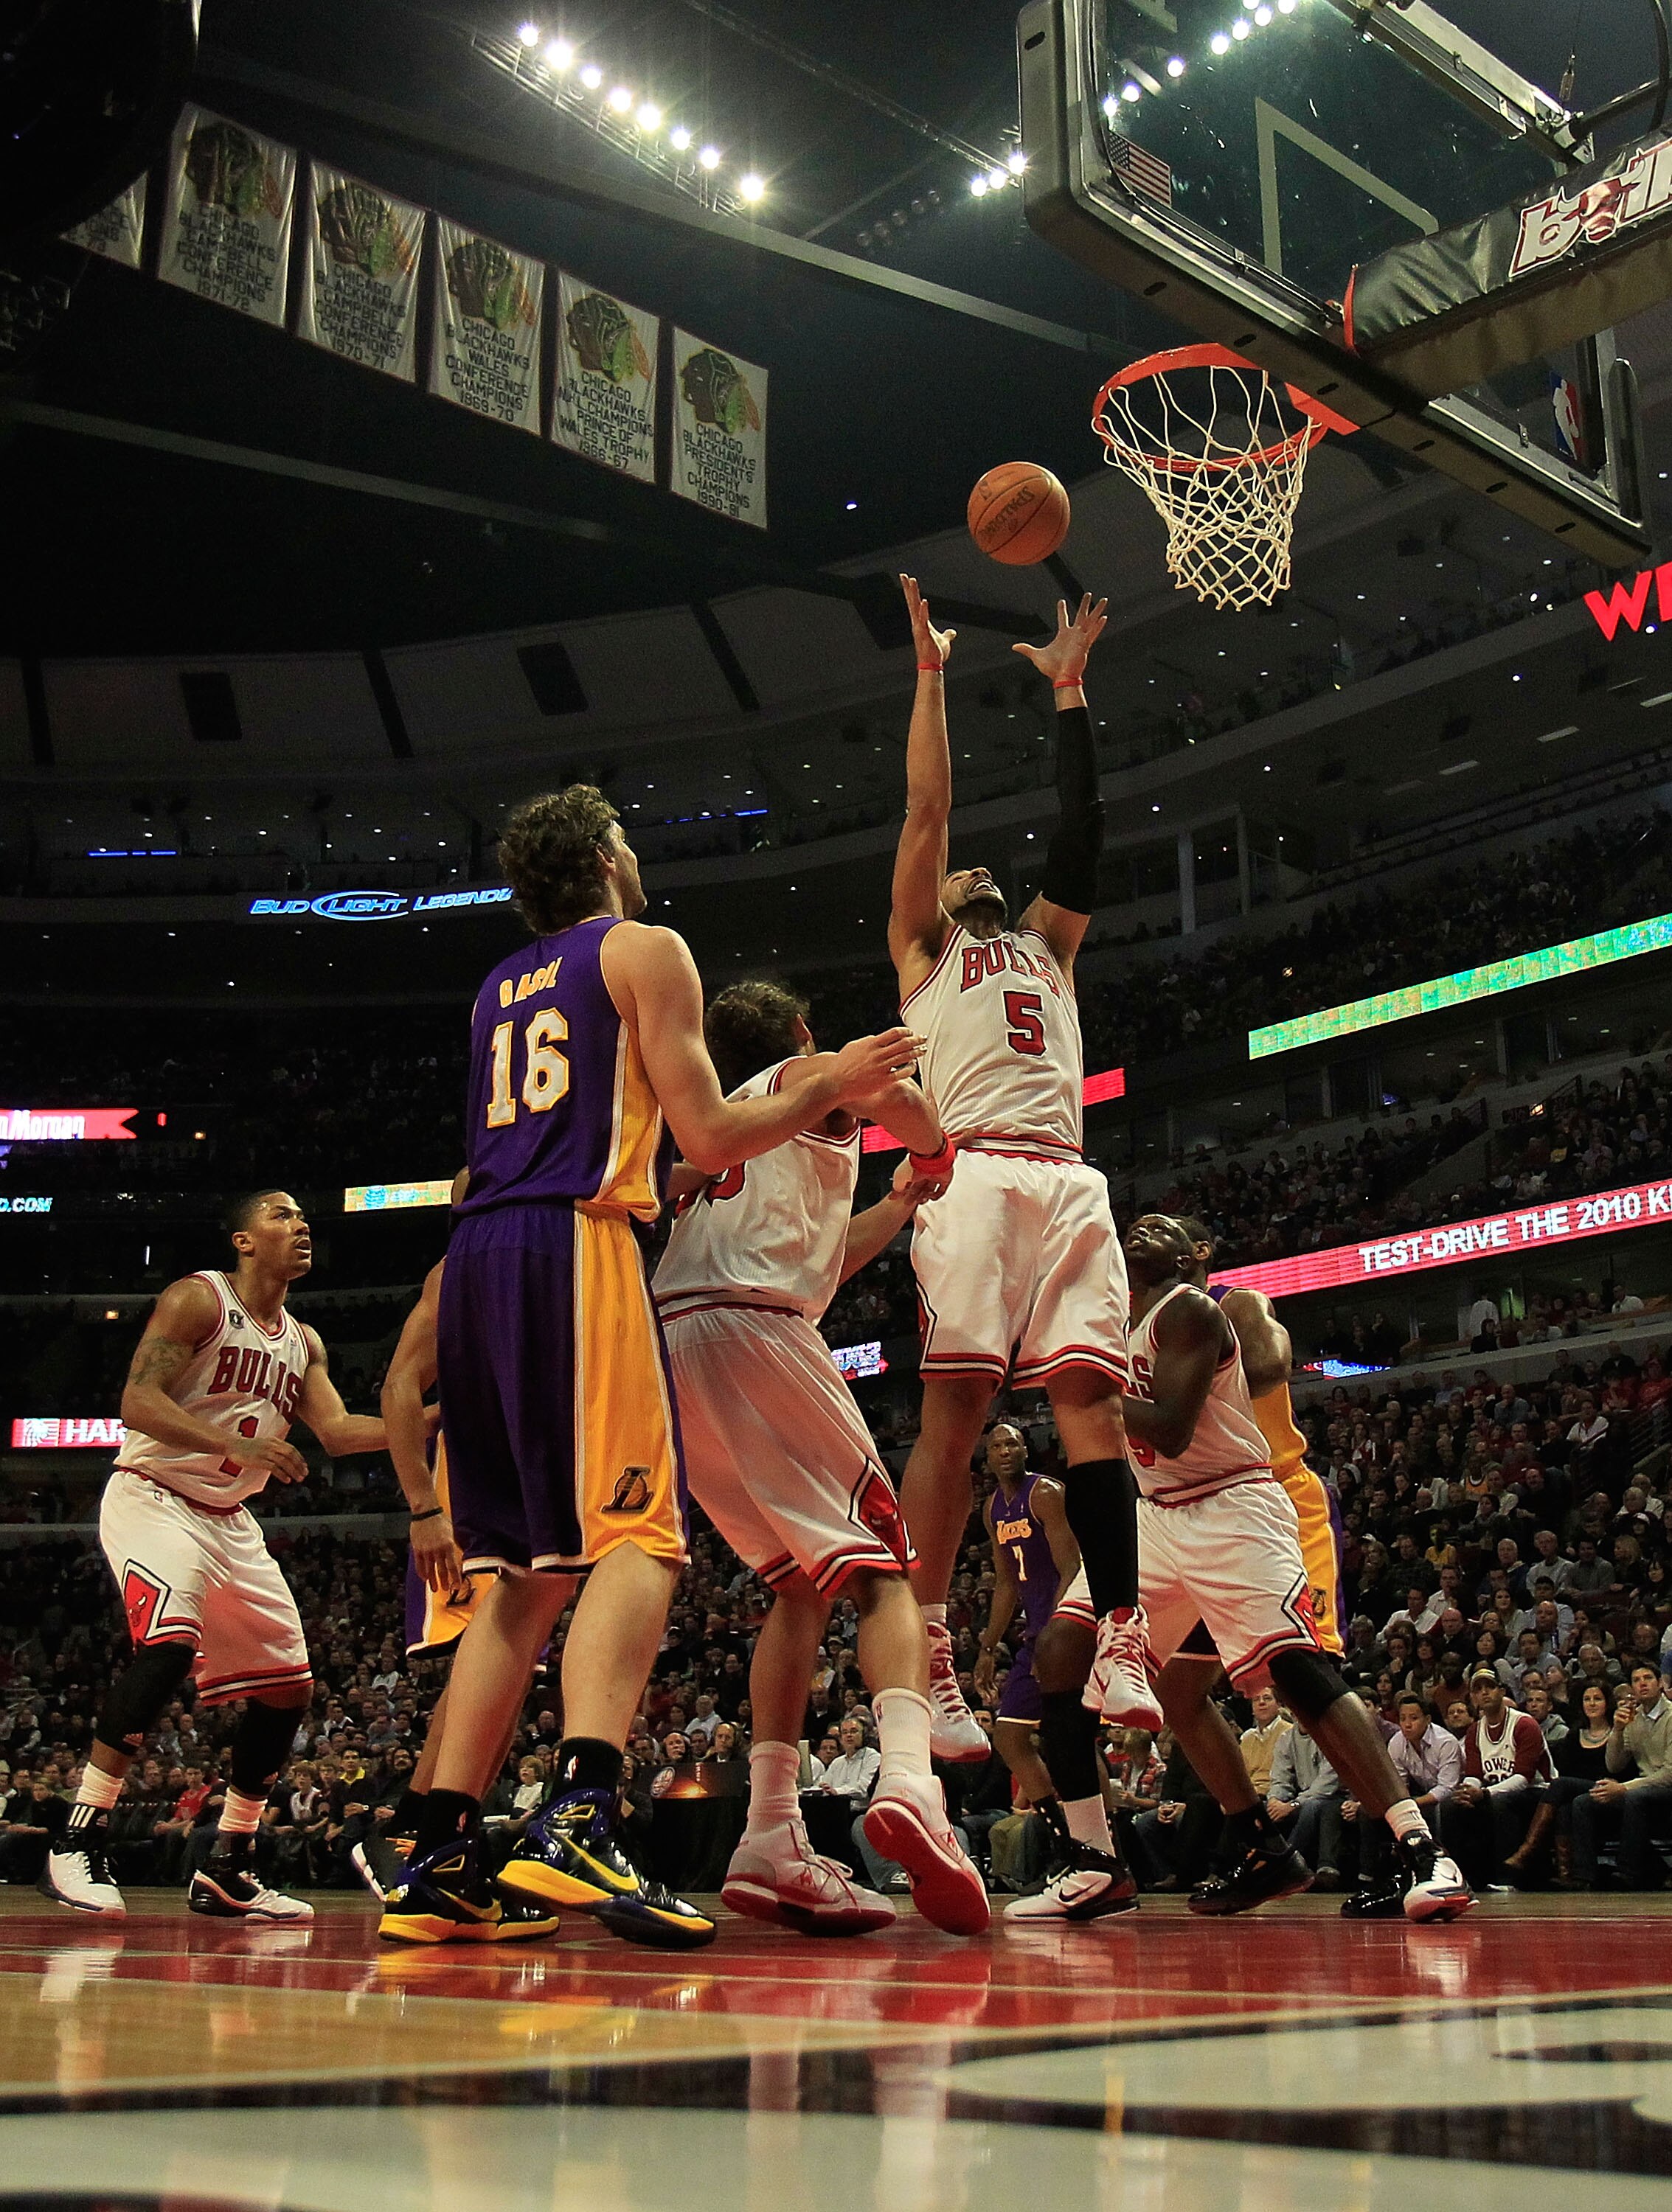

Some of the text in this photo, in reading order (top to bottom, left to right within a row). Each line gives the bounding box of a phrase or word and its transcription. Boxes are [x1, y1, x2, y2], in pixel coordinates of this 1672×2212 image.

[200, 206, 260, 240] CHICAGO
[334, 264, 391, 299] CHICAGO
[321, 317, 396, 359] CHAMPIONS
[333, 337, 384, 368] 1970-71
[445, 323, 530, 370] BLACKHAWKS
[462, 318, 515, 350] CHICAGO
[446, 354, 529, 398] CONFERENCE
[469, 349, 509, 378] WALES
[451, 372, 523, 411] CHAMPIONS
[569, 378, 646, 422] BLACKHAWKS
[581, 371, 631, 403] CHICAGO
[461, 390, 514, 422] 1969-70
[588, 402, 653, 437] CHAMPIONS
[560, 415, 650, 464] WALES TROPHY
[577, 410, 634, 444] PRINCE OF
[696, 422, 743, 453] CHICAGO
[579, 439, 628, 469] 1966-67
[683, 429, 756, 471] BLACKHAWKS
[684, 444, 753, 483] PRESIDENTS
[687, 471, 750, 508] CHAMPIONS
[697, 462, 740, 492] TROPHY
[697, 490, 739, 517] 1990-91
[250, 899, 310, 914] BUD
[327, 898, 409, 913] LIGHT
[960, 938, 1061, 1000] BULLS
[1002, 990, 1047, 1057] 5
[487, 1007, 569, 1128] 16
[1359, 1219, 1510, 1273] TEST-DRIVE
[1515, 1206, 1571, 1241] THE
[1575, 1192, 1642, 1230] 2010
[207, 1346, 303, 1426] BULLS
[1011, 1545, 1028, 1582] 7
